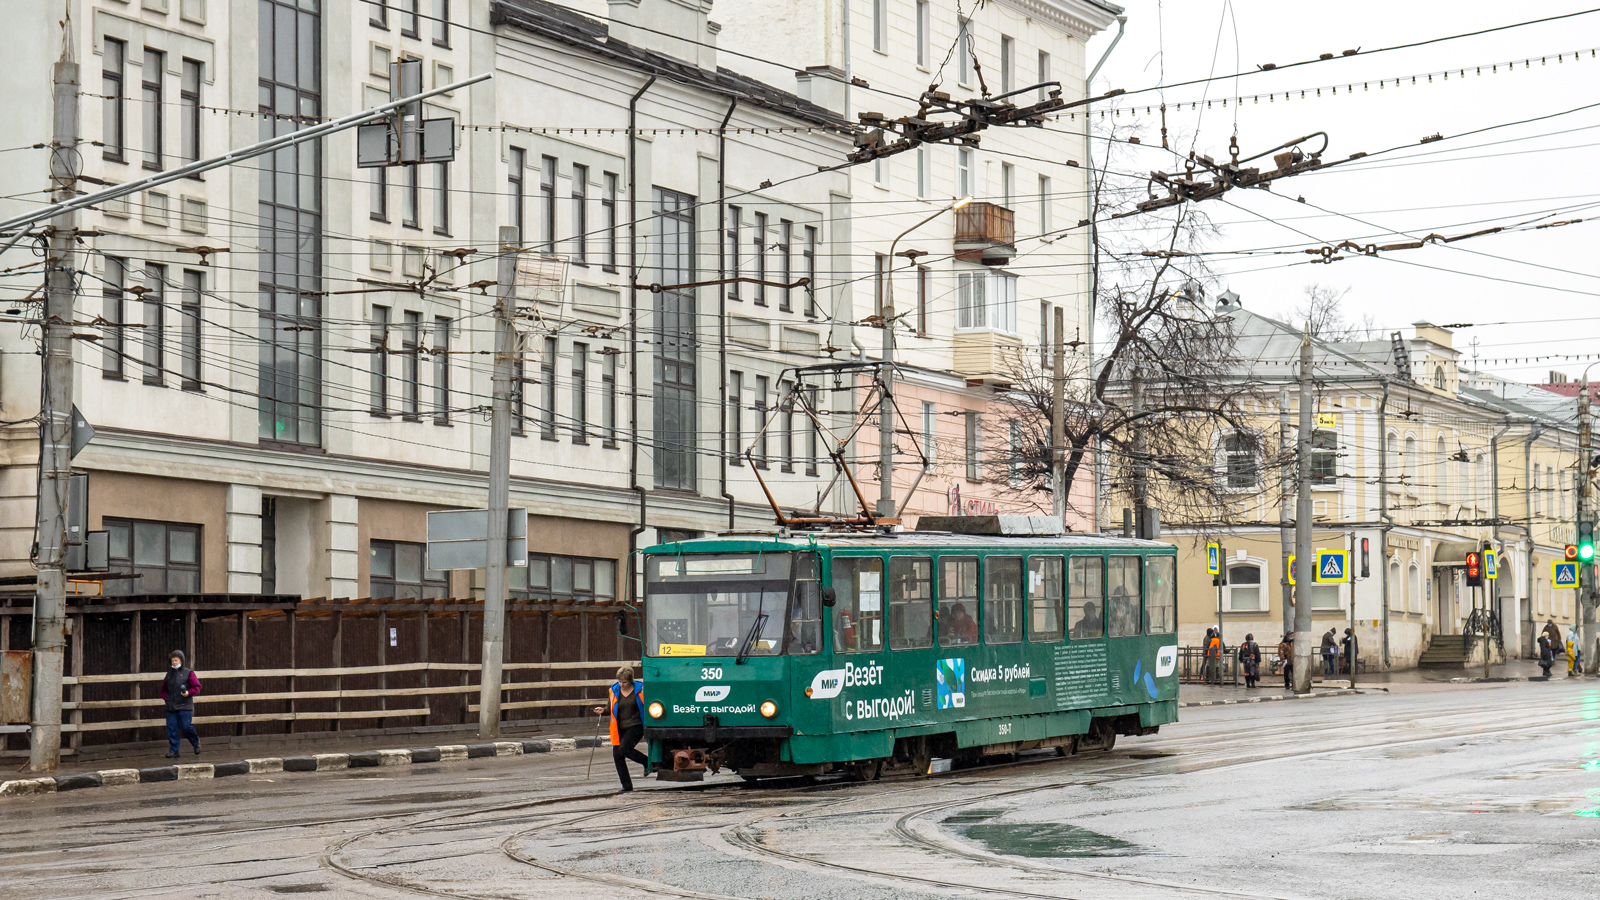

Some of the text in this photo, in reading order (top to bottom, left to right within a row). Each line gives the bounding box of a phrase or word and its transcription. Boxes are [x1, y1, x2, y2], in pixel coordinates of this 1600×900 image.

[1319, 416, 1324, 424] 5
[662, 646, 672, 654] 12
[700, 667, 723, 680] 350
[845, 660, 884, 687] Везёт
[970, 663, 1030, 683] Скидка 5 рублей
[821, 678, 839, 690] МИР
[672, 704, 701, 713] Везёт
[711, 704, 756, 714] выгодой!
[845, 689, 916, 721] с выгодой!
